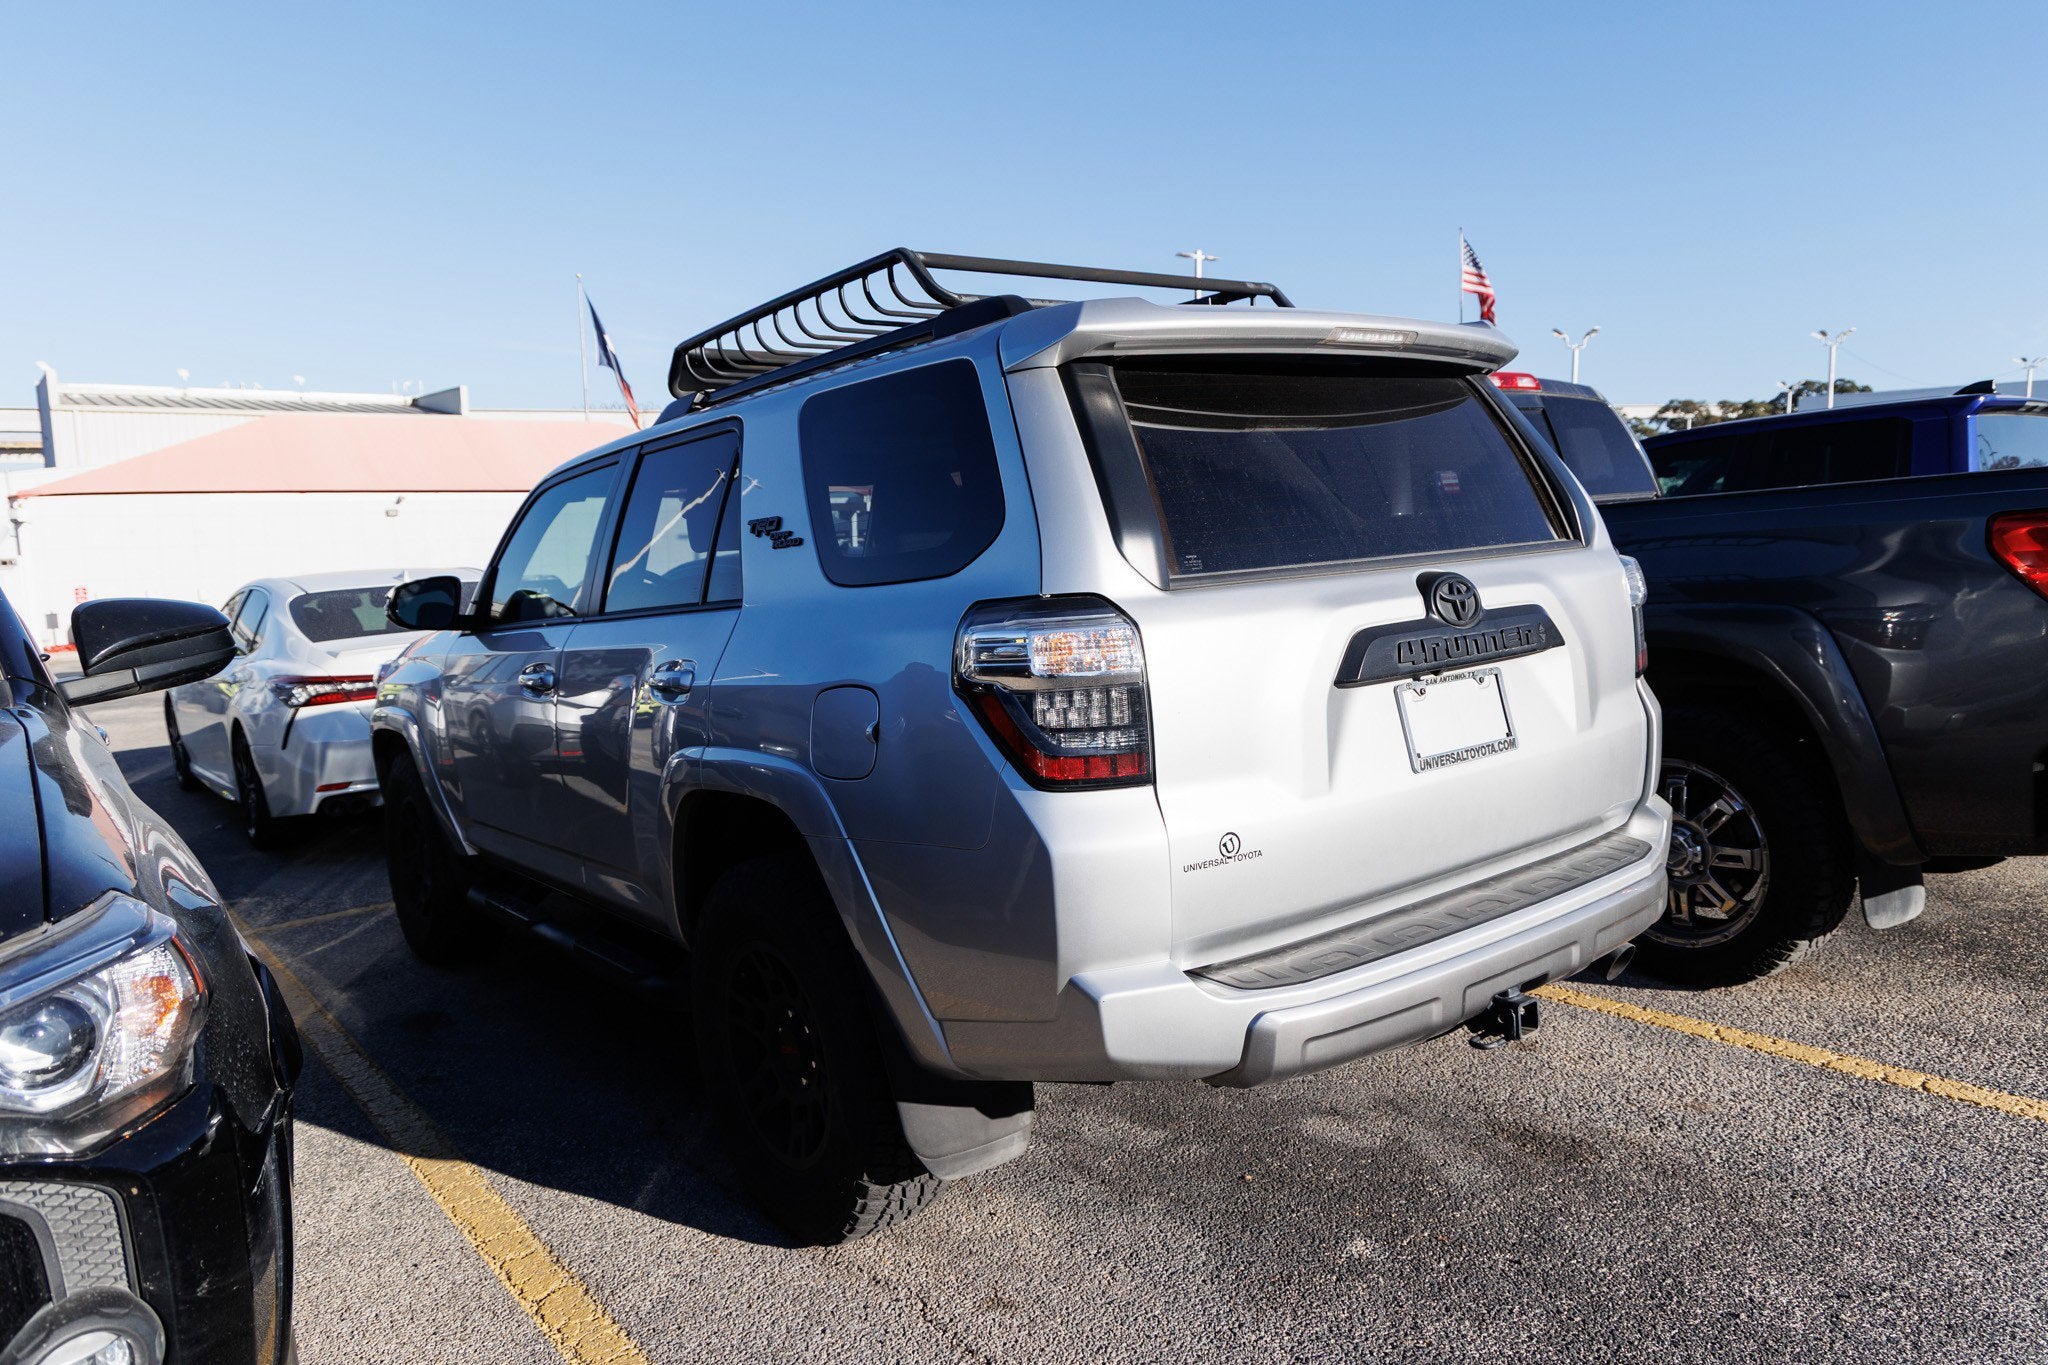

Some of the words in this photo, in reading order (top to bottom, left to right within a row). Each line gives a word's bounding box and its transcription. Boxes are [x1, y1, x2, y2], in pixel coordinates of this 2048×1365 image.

[1425, 677, 1438, 686] SAN
[1419, 738, 1517, 771] UNIVERSALTOYOTA.COM
[1183, 857, 1229, 873] UNIVERSAL
[1232, 849, 1263, 863] TOYOTA
